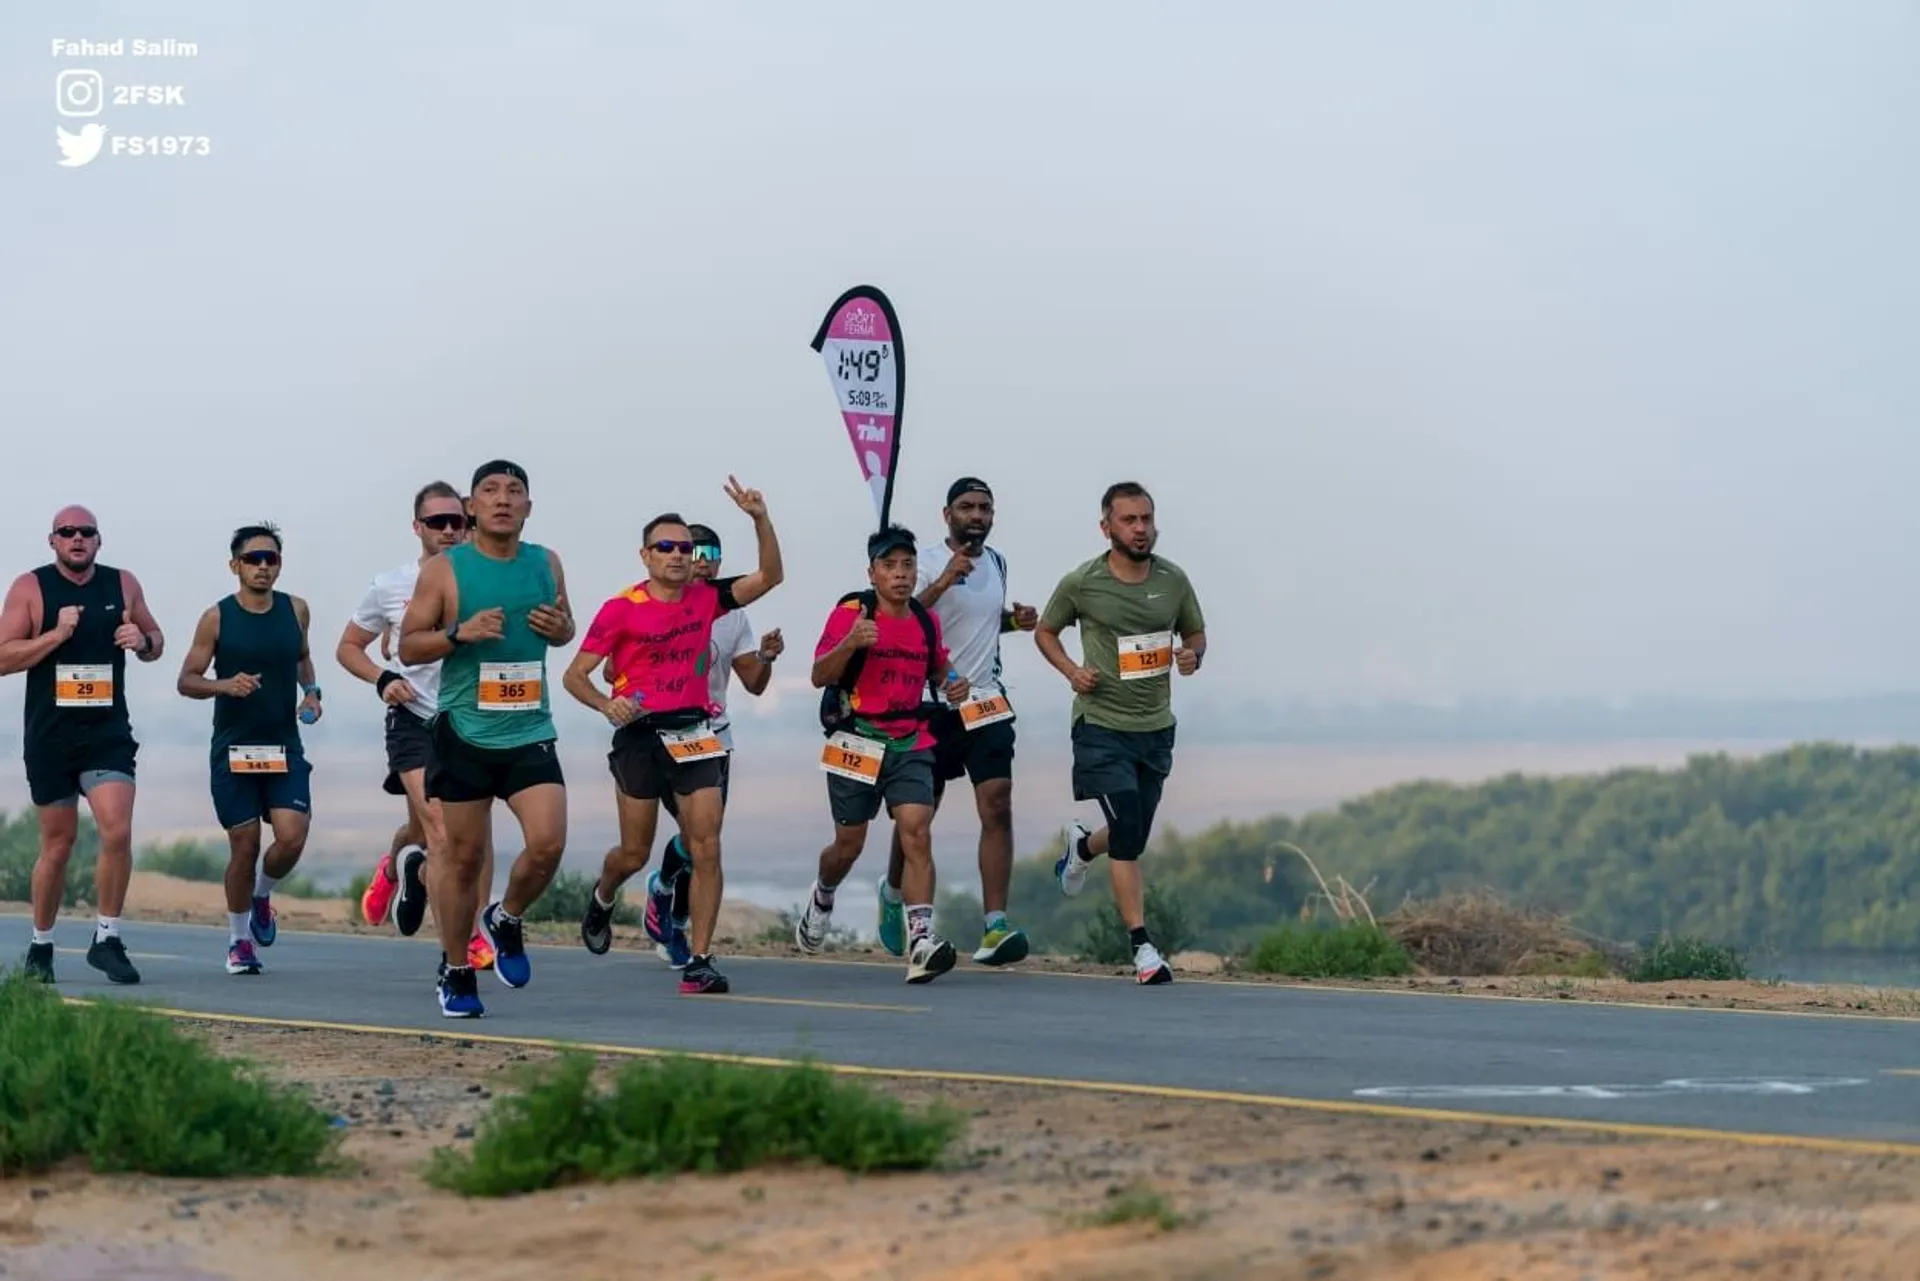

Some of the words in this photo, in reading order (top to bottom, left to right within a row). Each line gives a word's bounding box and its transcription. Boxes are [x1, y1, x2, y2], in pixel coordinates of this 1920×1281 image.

[838, 348, 881, 382] 1:49
[848, 389, 871, 407] 5:09
[1139, 652, 1158, 665] 121
[76, 682, 94, 695] 29
[499, 683, 526, 698] 365
[683, 741, 705, 753] 115
[842, 751, 862, 768] 112
